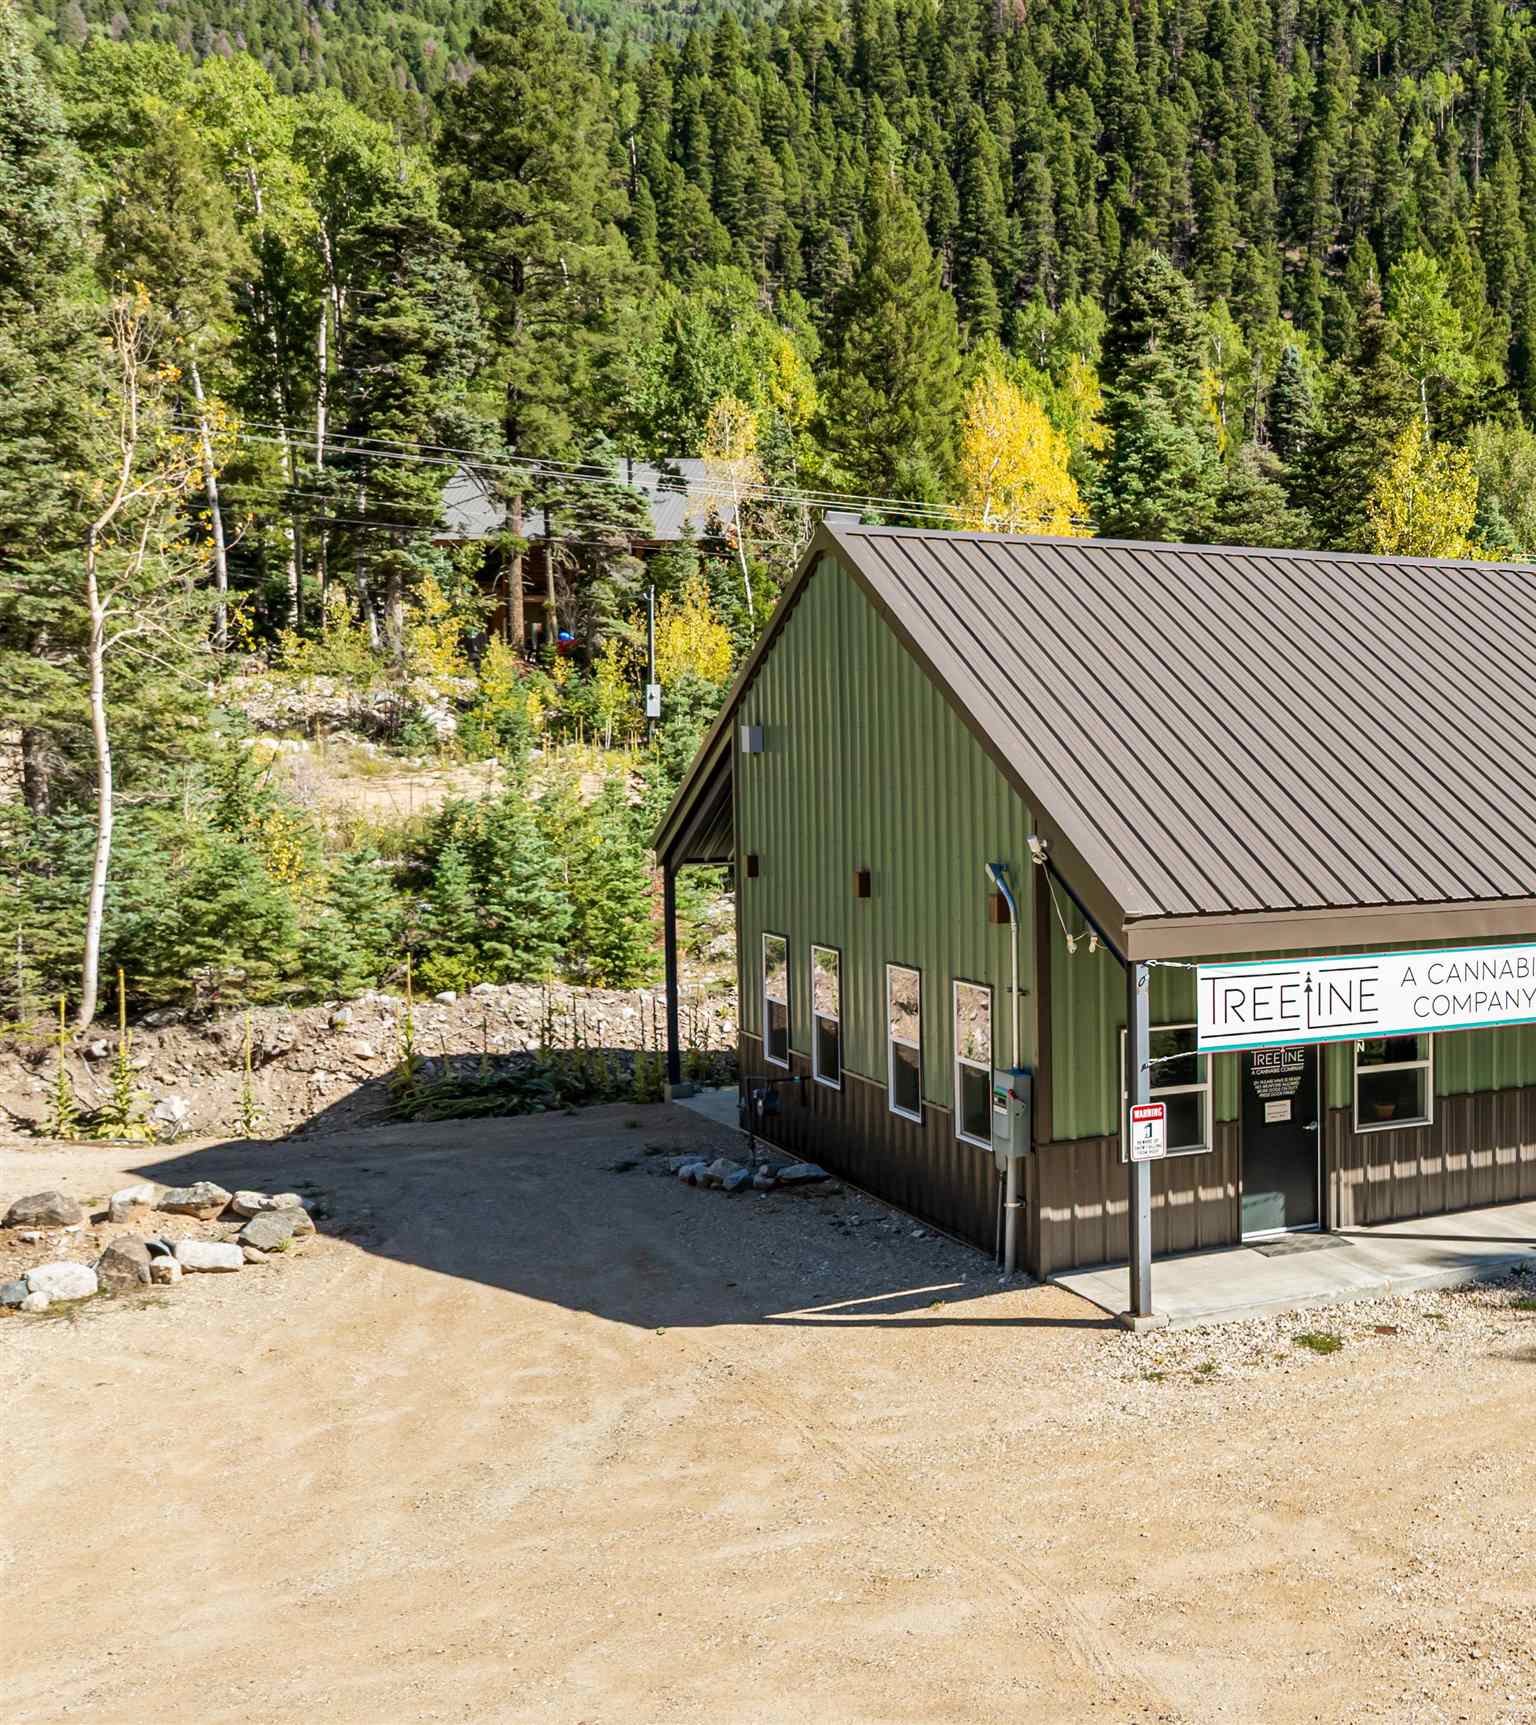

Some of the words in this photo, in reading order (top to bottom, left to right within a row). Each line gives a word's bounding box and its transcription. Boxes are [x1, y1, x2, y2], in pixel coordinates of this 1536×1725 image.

[1400, 966, 1417, 988] A
[1200, 967, 1379, 1036] TREELINE
[1250, 1047, 1305, 1069] TREELINE
[1133, 1107, 1163, 1118] WARNING
